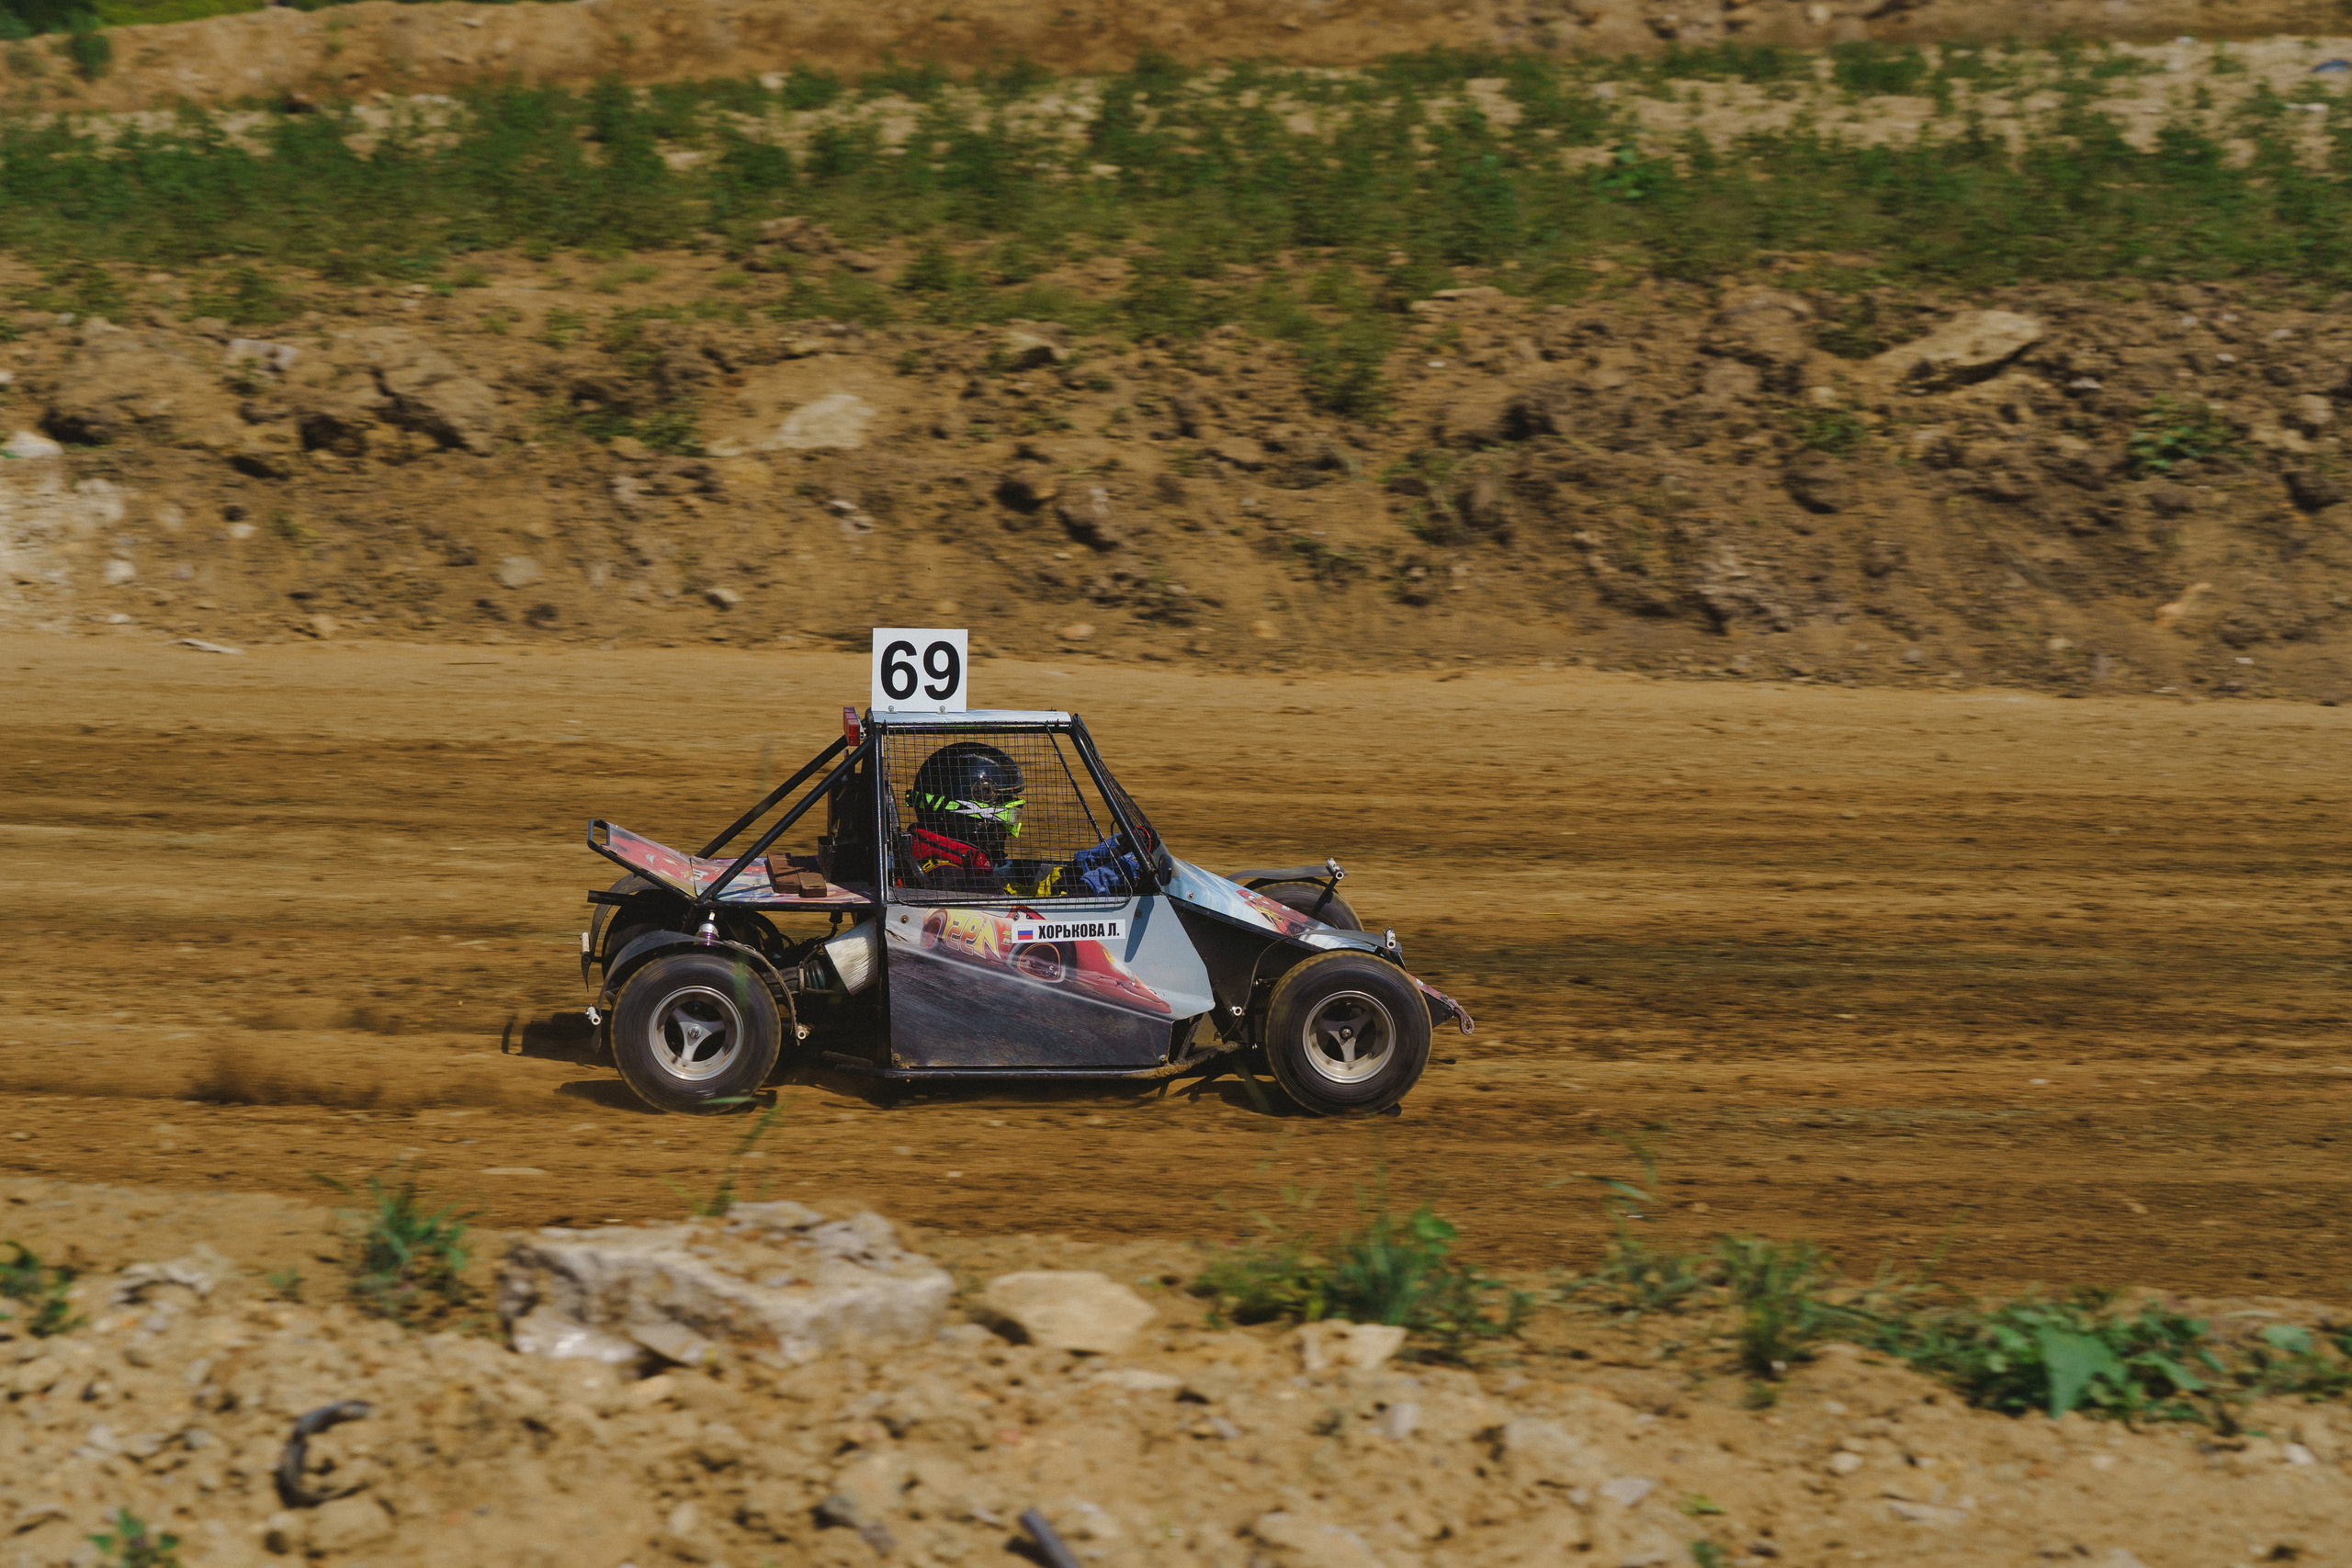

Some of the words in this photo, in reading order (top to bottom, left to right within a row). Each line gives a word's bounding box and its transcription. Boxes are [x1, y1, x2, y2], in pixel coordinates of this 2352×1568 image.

[881, 640, 961, 701] 69
[1038, 923, 1105, 940] ХОРЬКОВА
[1107, 922, 1120, 937] Л.
